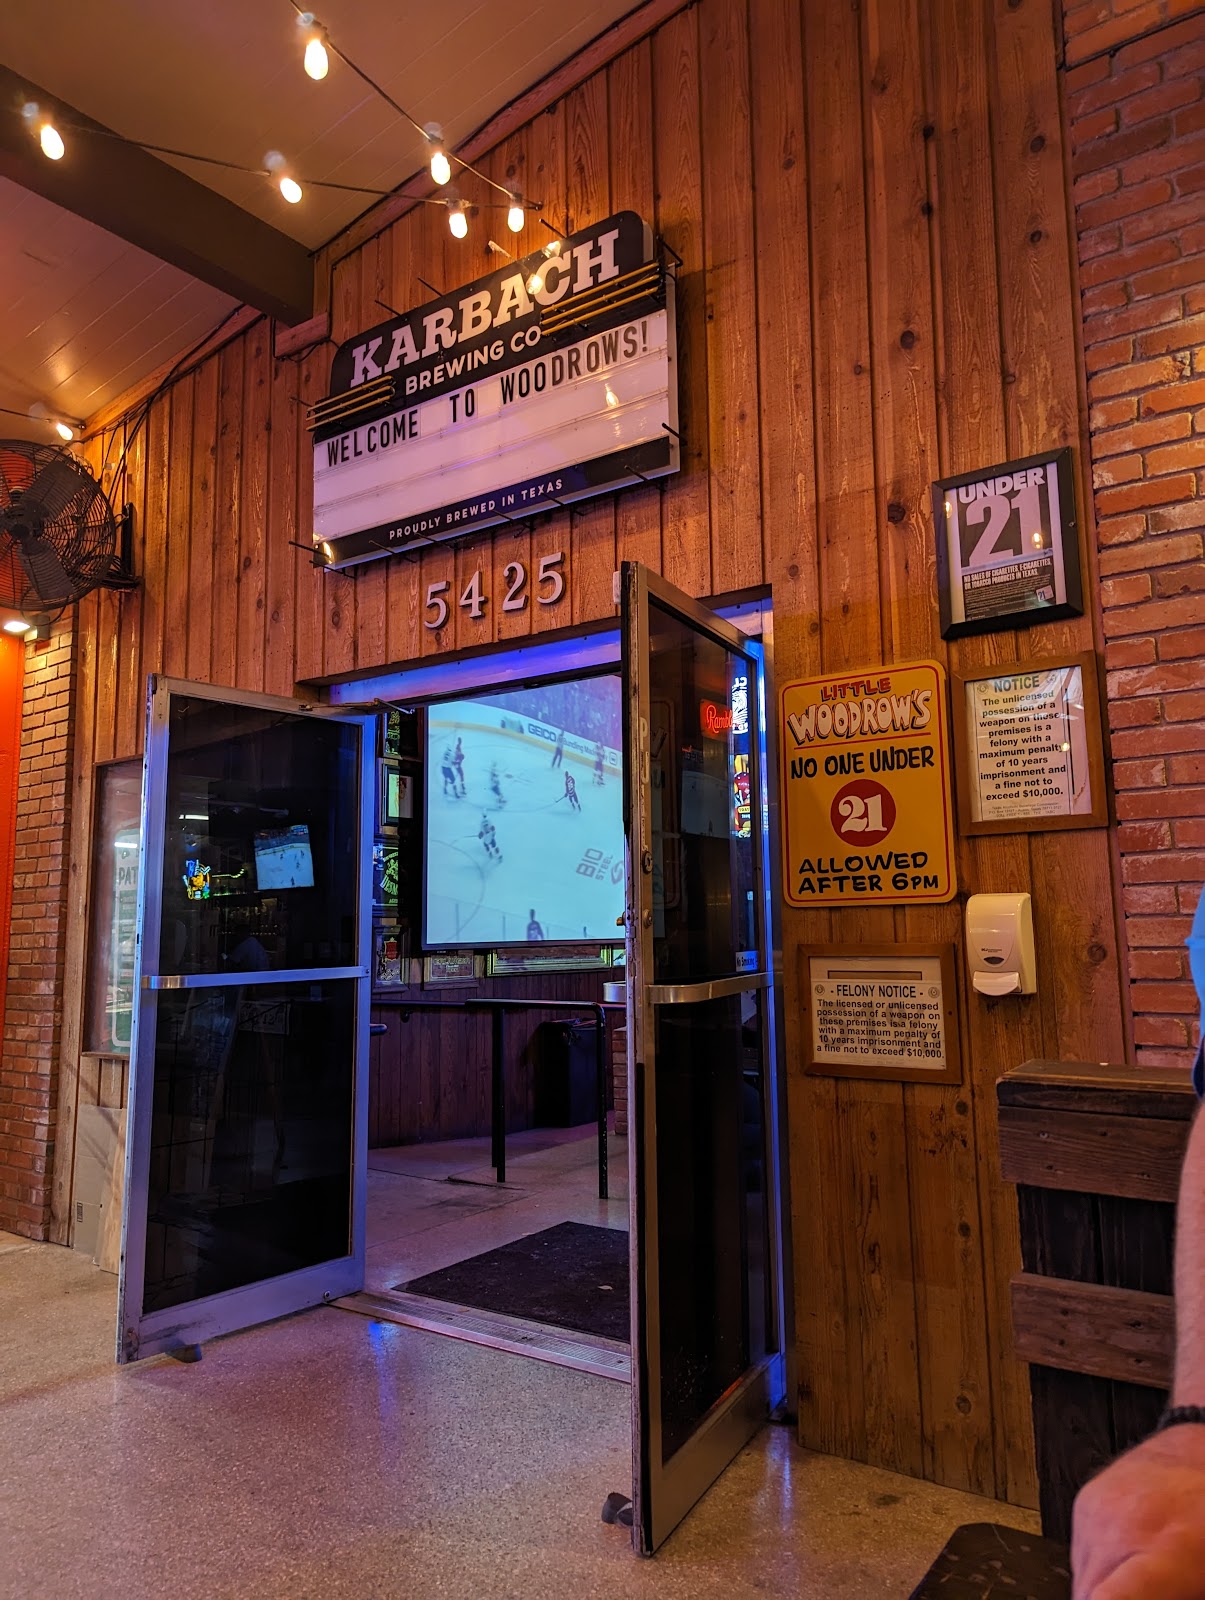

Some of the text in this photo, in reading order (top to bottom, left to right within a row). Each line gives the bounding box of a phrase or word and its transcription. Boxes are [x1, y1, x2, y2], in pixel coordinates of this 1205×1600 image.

[350, 229, 620, 388] KARBACH
[405, 340, 505, 396] BREWING
[327, 321, 649, 467] WELCOME TO WOODROWS!
[959, 467, 1045, 504] UNDER
[389, 479, 563, 540] PROUDLY BREWED IN TEXAS
[966, 486, 1042, 567] 21
[424, 552, 566, 630] 5425
[821, 677, 892, 702] LITTLE
[994, 676, 1040, 693] NOTICE
[1002, 691, 1054, 703] unlicensed
[786, 689, 932, 746] WOODROW'S
[982, 705, 1034, 718] possession
[1038, 702, 1047, 710] of
[979, 716, 1015, 727] weapon
[1033, 712, 1060, 721] these
[528, 723, 557, 742] GEICO
[989, 725, 1031, 738] premises
[990, 737, 1019, 748] felony
[1022, 735, 1042, 744] with
[979, 744, 1063, 759] maximum penalty
[791, 745, 935, 779] NO ONE UNDER
[996, 756, 1048, 768] of 10 years
[980, 765, 1066, 780] imprisonment and
[1003, 780, 1021, 789] fine
[1024, 777, 1040, 787] not
[1043, 777, 1053, 785] to
[986, 787, 1064, 801] exceed $10,000.
[838, 793, 888, 834] 21
[799, 851, 928, 875] ALLOWED
[798, 873, 939, 895] AFTER 6PM
[836, 984, 917, 998] FELONY NOTICE
[817, 999, 939, 1011] The licensed or unlicensed
[817, 1008, 867, 1018] possession
[869, 1009, 879, 1018] of
[889, 1011, 925, 1021] weapon
[819, 1017, 844, 1026] these
[846, 1018, 887, 1030] premises
[890, 1019, 898, 1028] is
[909, 1020, 938, 1031] felony
[818, 1025, 837, 1034] with
[847, 1027, 891, 1037] maximum
[894, 1029, 928, 1040] penalty
[931, 1030, 941, 1039] of
[819, 1035, 941, 1049] 10 years imprisonment and
[824, 1043, 841, 1053] fine
[843, 1045, 858, 1054] not
[860, 1046, 870, 1054] to
[872, 1047, 904, 1056] exceed
[907, 1047, 945, 1059] $10,000.
